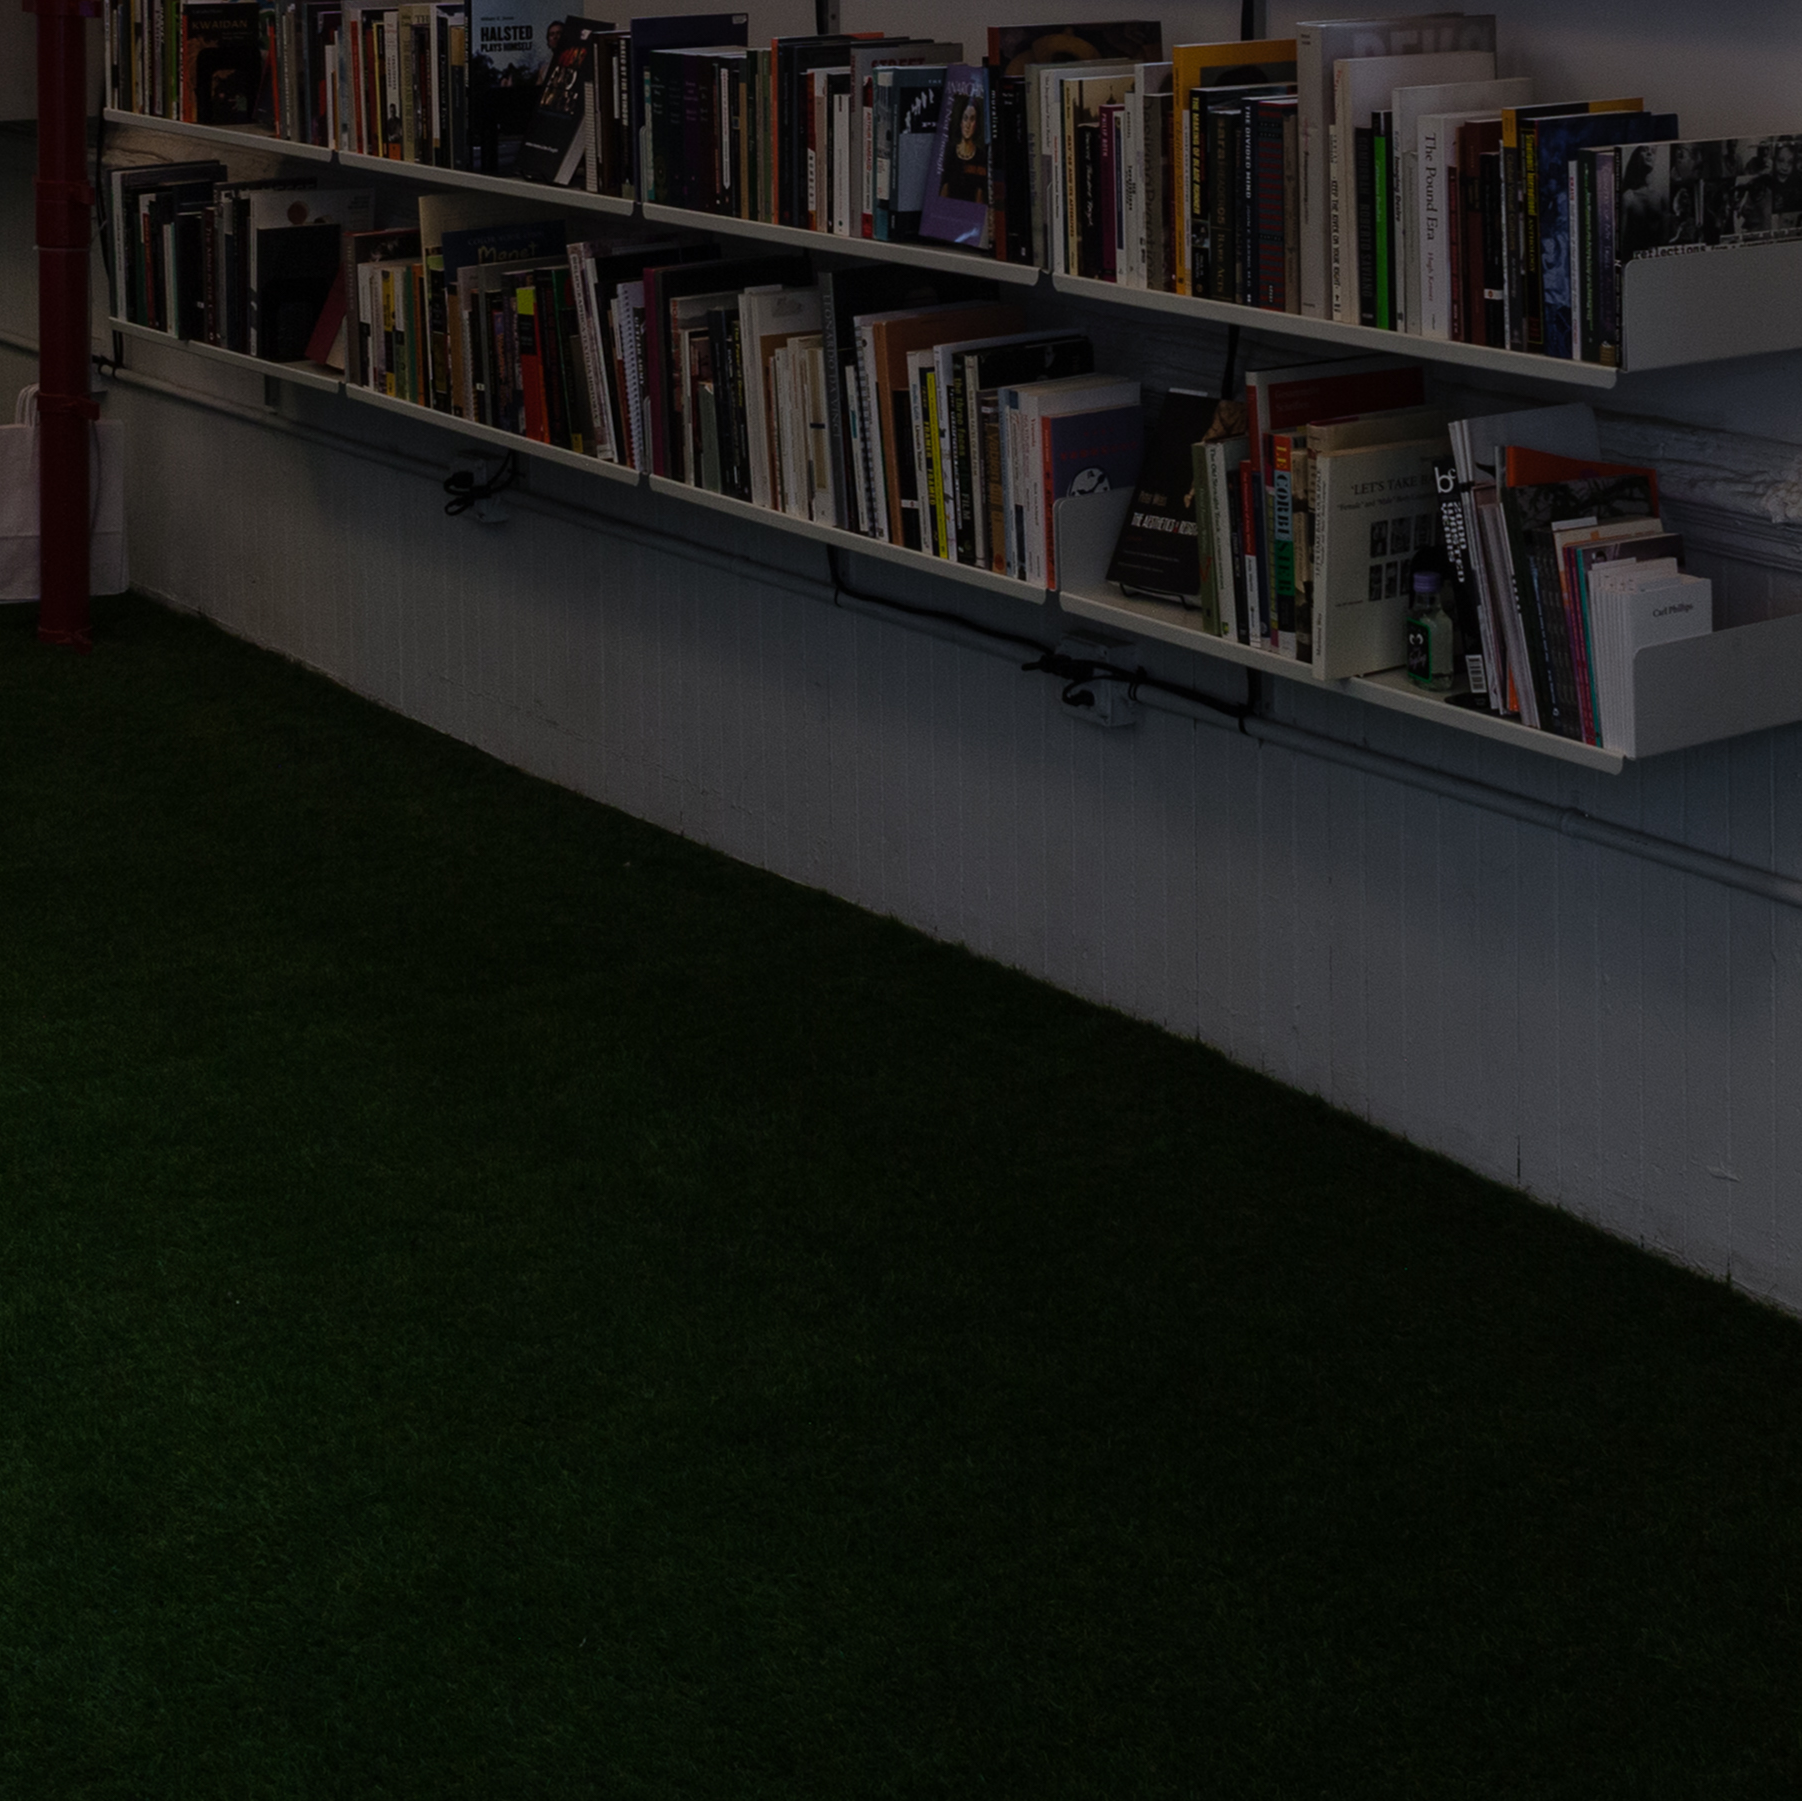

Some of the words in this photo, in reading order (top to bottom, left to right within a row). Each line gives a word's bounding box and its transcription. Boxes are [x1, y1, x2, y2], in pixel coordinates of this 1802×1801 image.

[192, 17, 248, 31] KWAIDAN
[480, 25, 533, 42] HALSTED
[481, 42, 502, 53] PLAYS
[503, 41, 533, 51] HIMSELF
[1425, 132, 1436, 162] The
[1426, 166, 1438, 213] Pound
[1427, 216, 1438, 241] Era
[1632, 244, 1706, 261] reflections
[1387, 476, 1418, 491] TAKE
[1652, 608, 1668, 618] Carl
